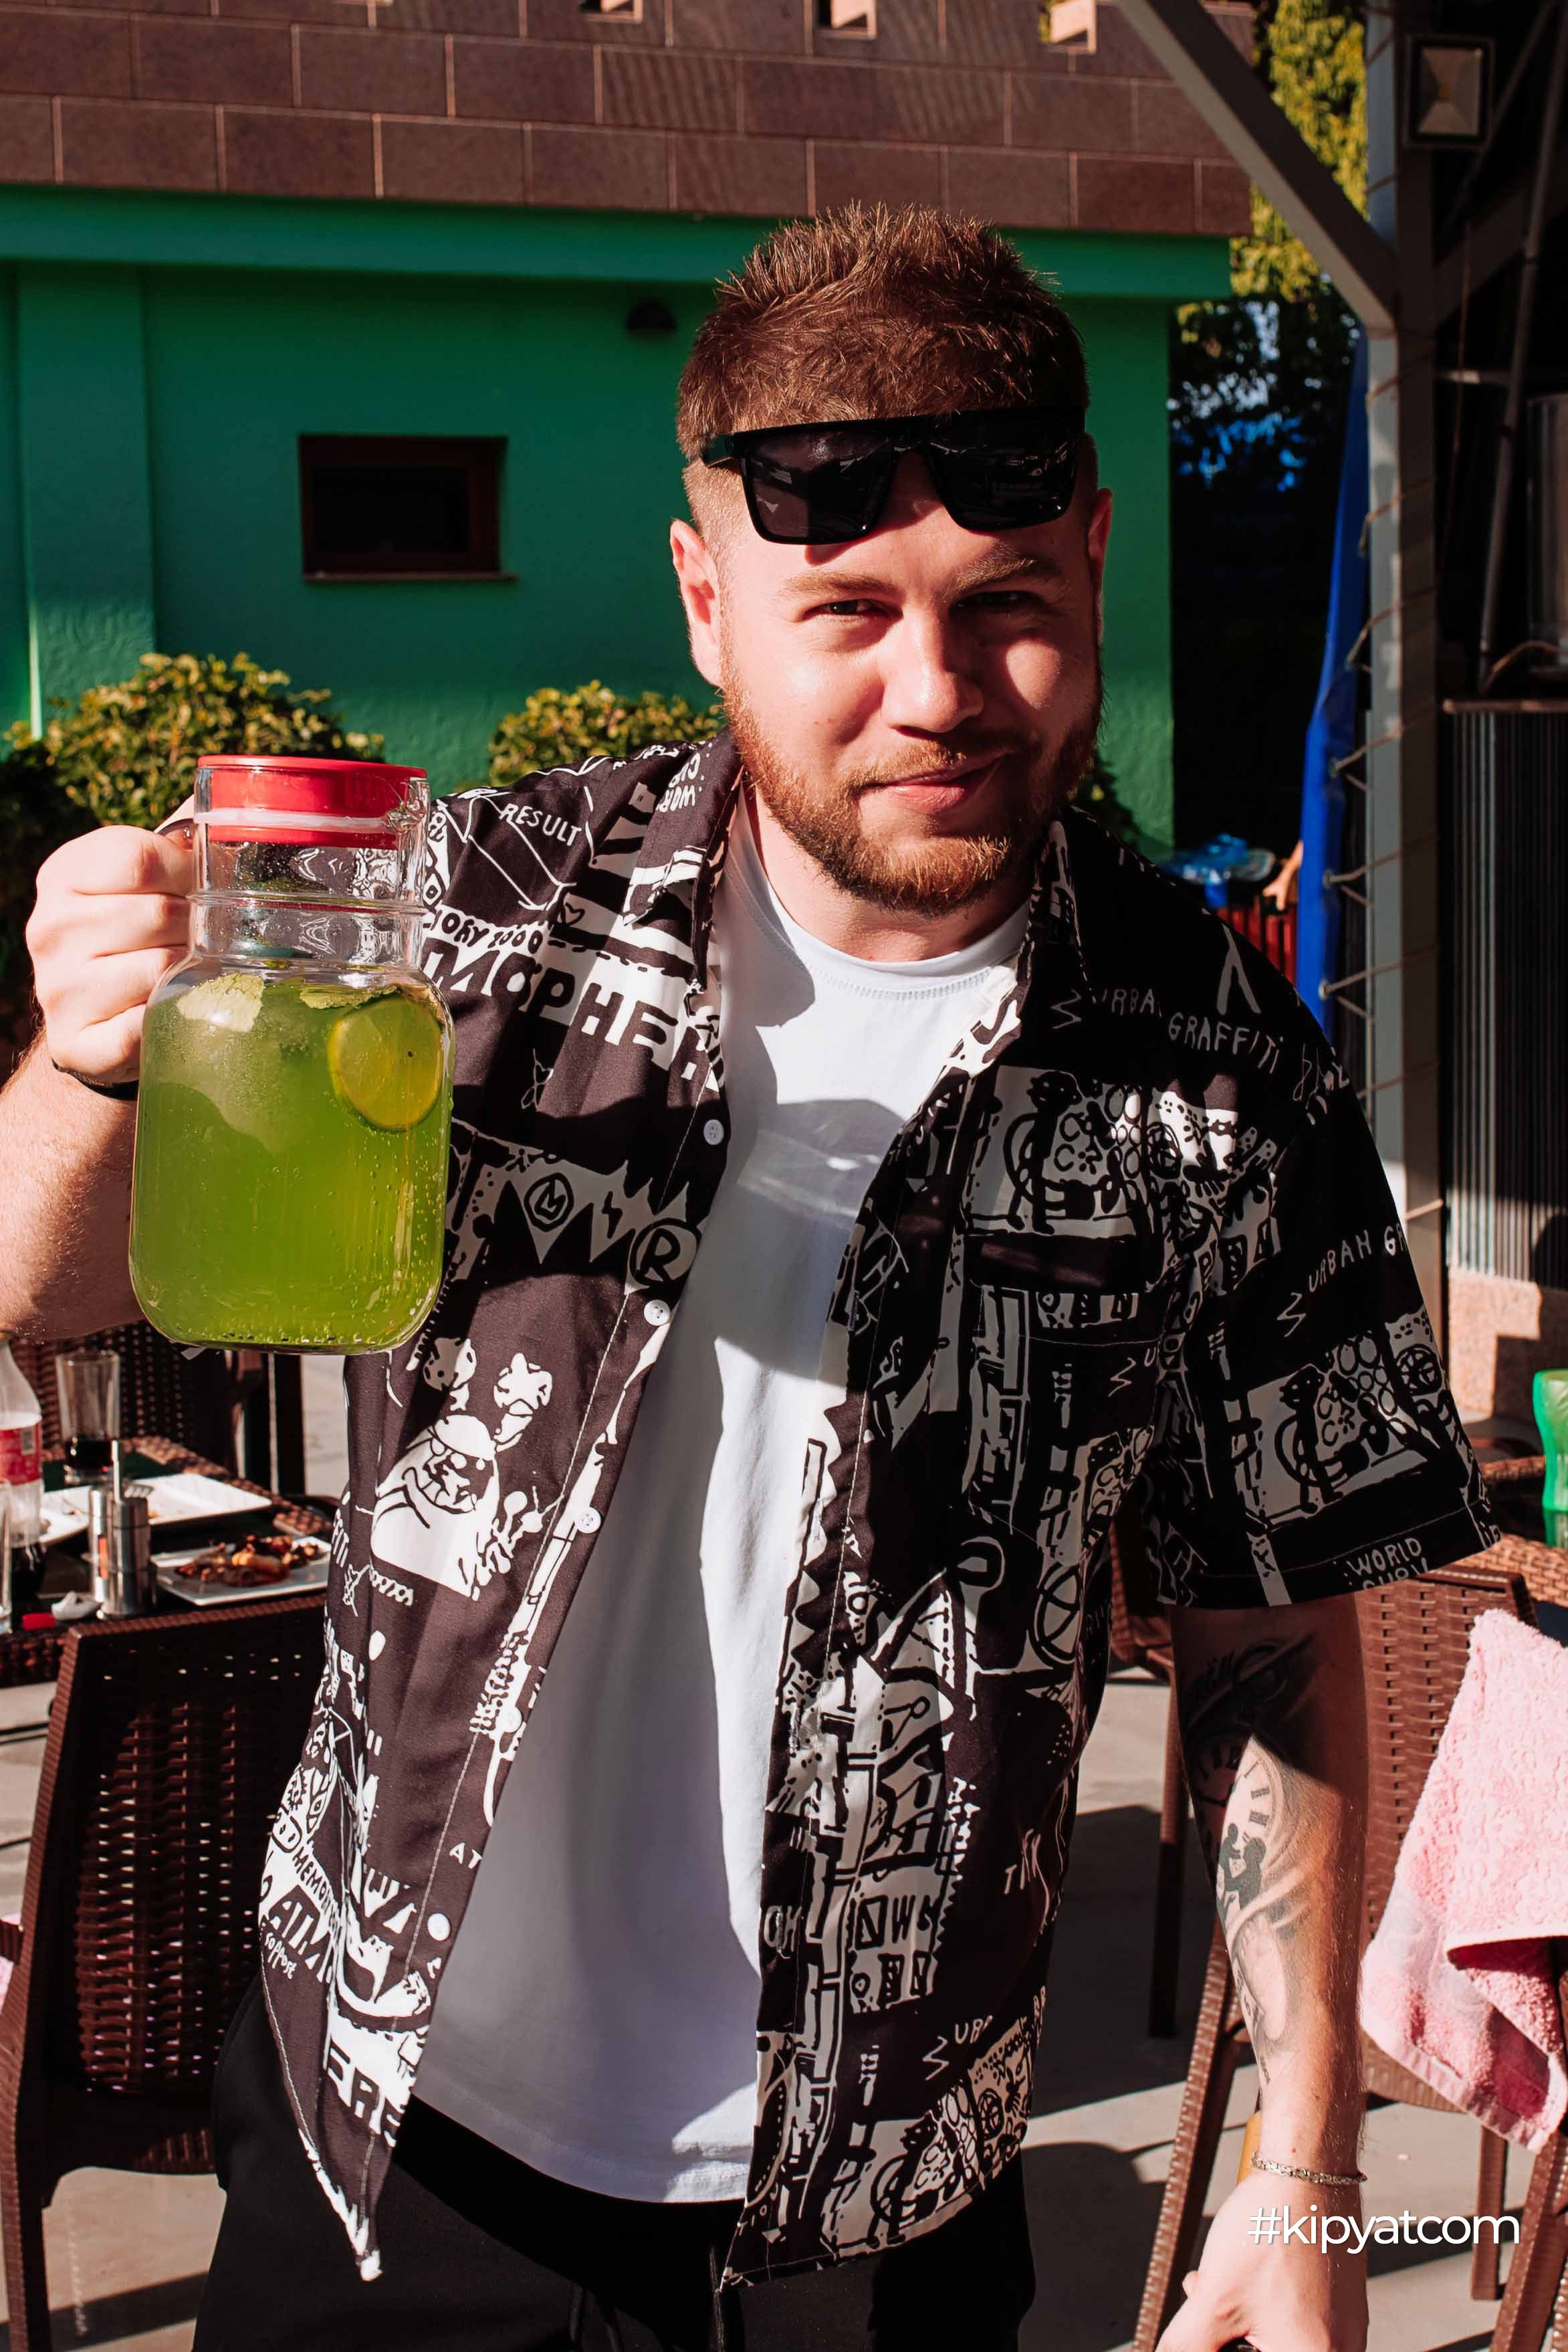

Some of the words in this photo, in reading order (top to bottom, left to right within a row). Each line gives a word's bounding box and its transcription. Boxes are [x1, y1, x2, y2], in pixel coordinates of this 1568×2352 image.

[500, 803, 582, 846] RESULT
[1167, 1012, 1284, 1073] GRAFFITI
[1345, 1537, 1422, 1576] WORLD
